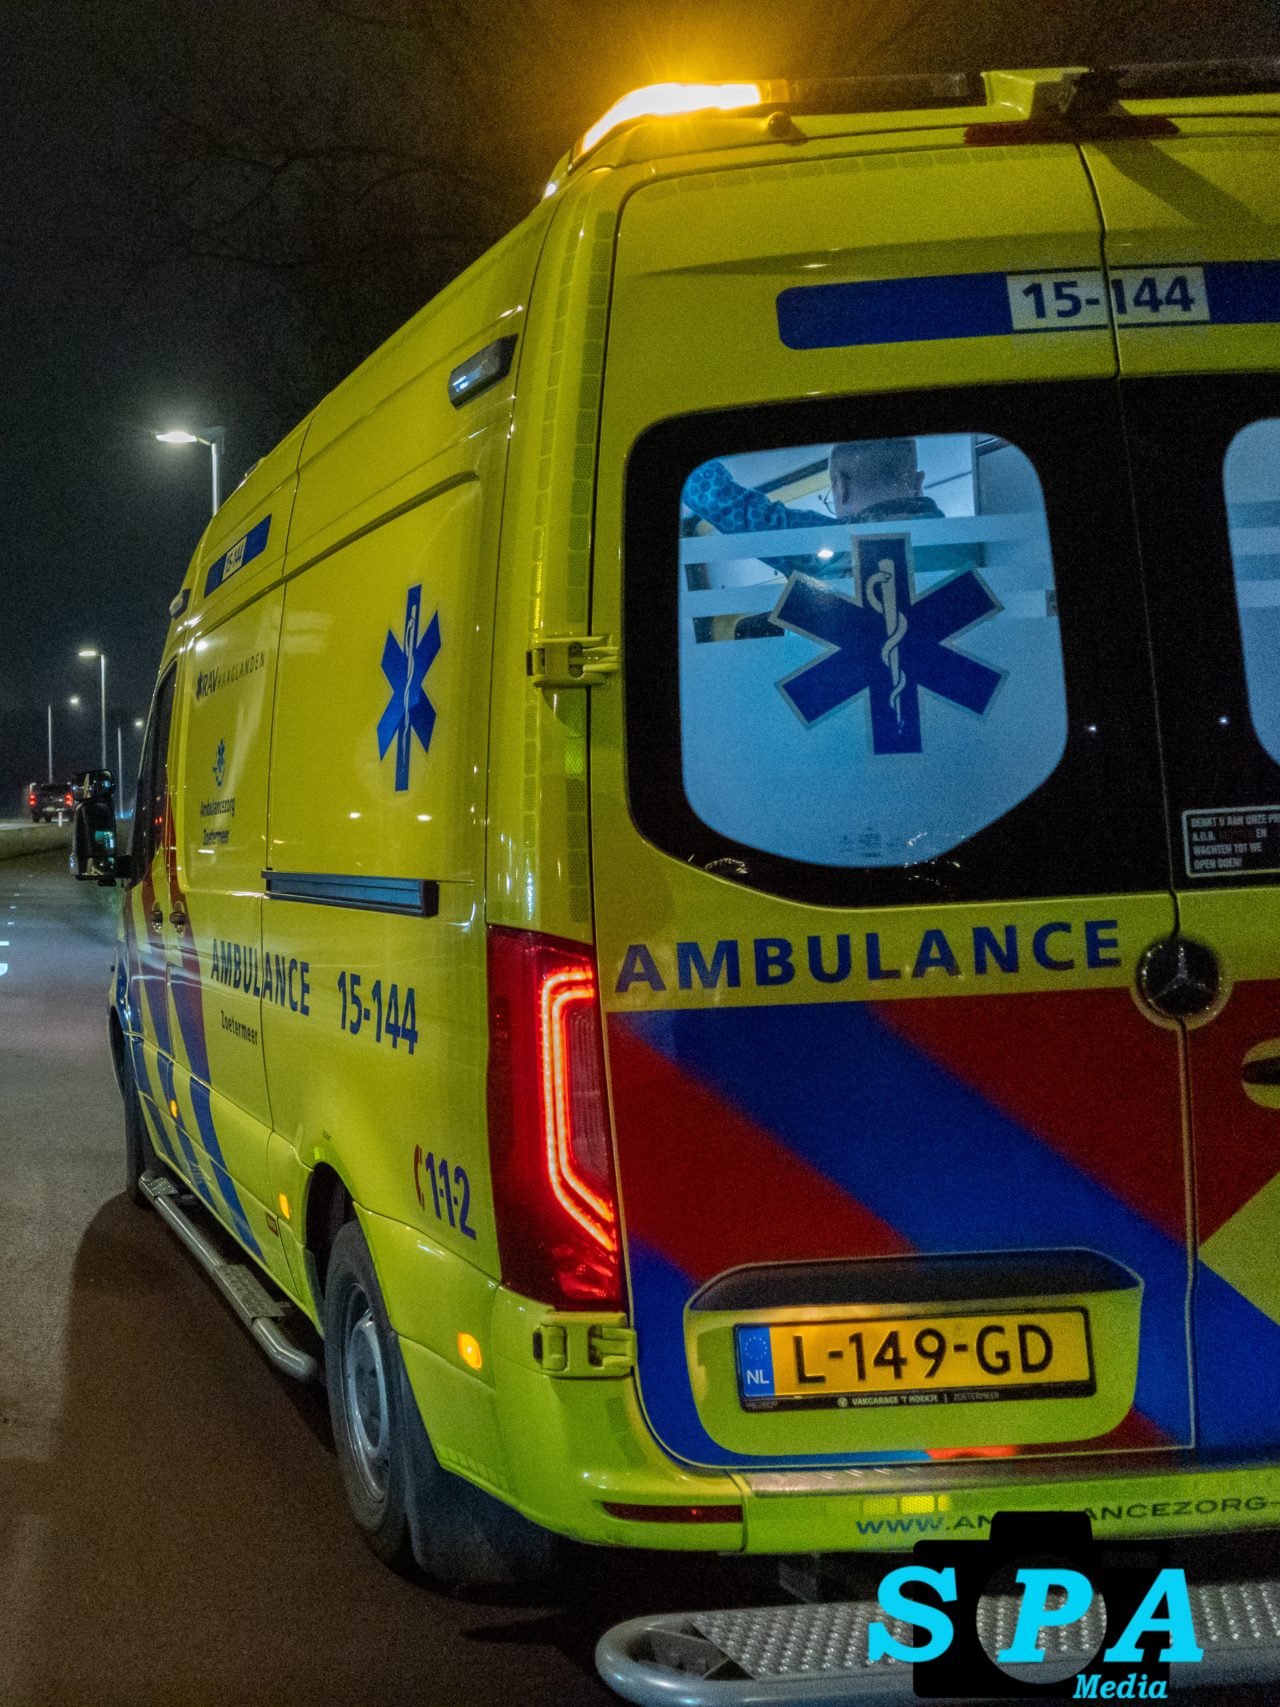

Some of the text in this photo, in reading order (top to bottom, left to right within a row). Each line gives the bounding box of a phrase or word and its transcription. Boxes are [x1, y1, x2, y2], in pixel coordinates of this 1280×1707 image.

[1022, 275, 1195, 319] 15-144
[202, 667, 219, 698] RAV
[200, 798, 235, 817] Ambulancezorg
[1256, 828, 1267, 838] EN
[615, 919, 1121, 994] AMBULANCE
[211, 938, 418, 1055] AMBULANCE 15-144
[221, 1009, 258, 1045] Zoetermeer
[793, 1324, 1054, 1384] L-149-GD
[746, 1369, 770, 1385] NL
[852, 1395, 899, 1407] VAKGARAGE
